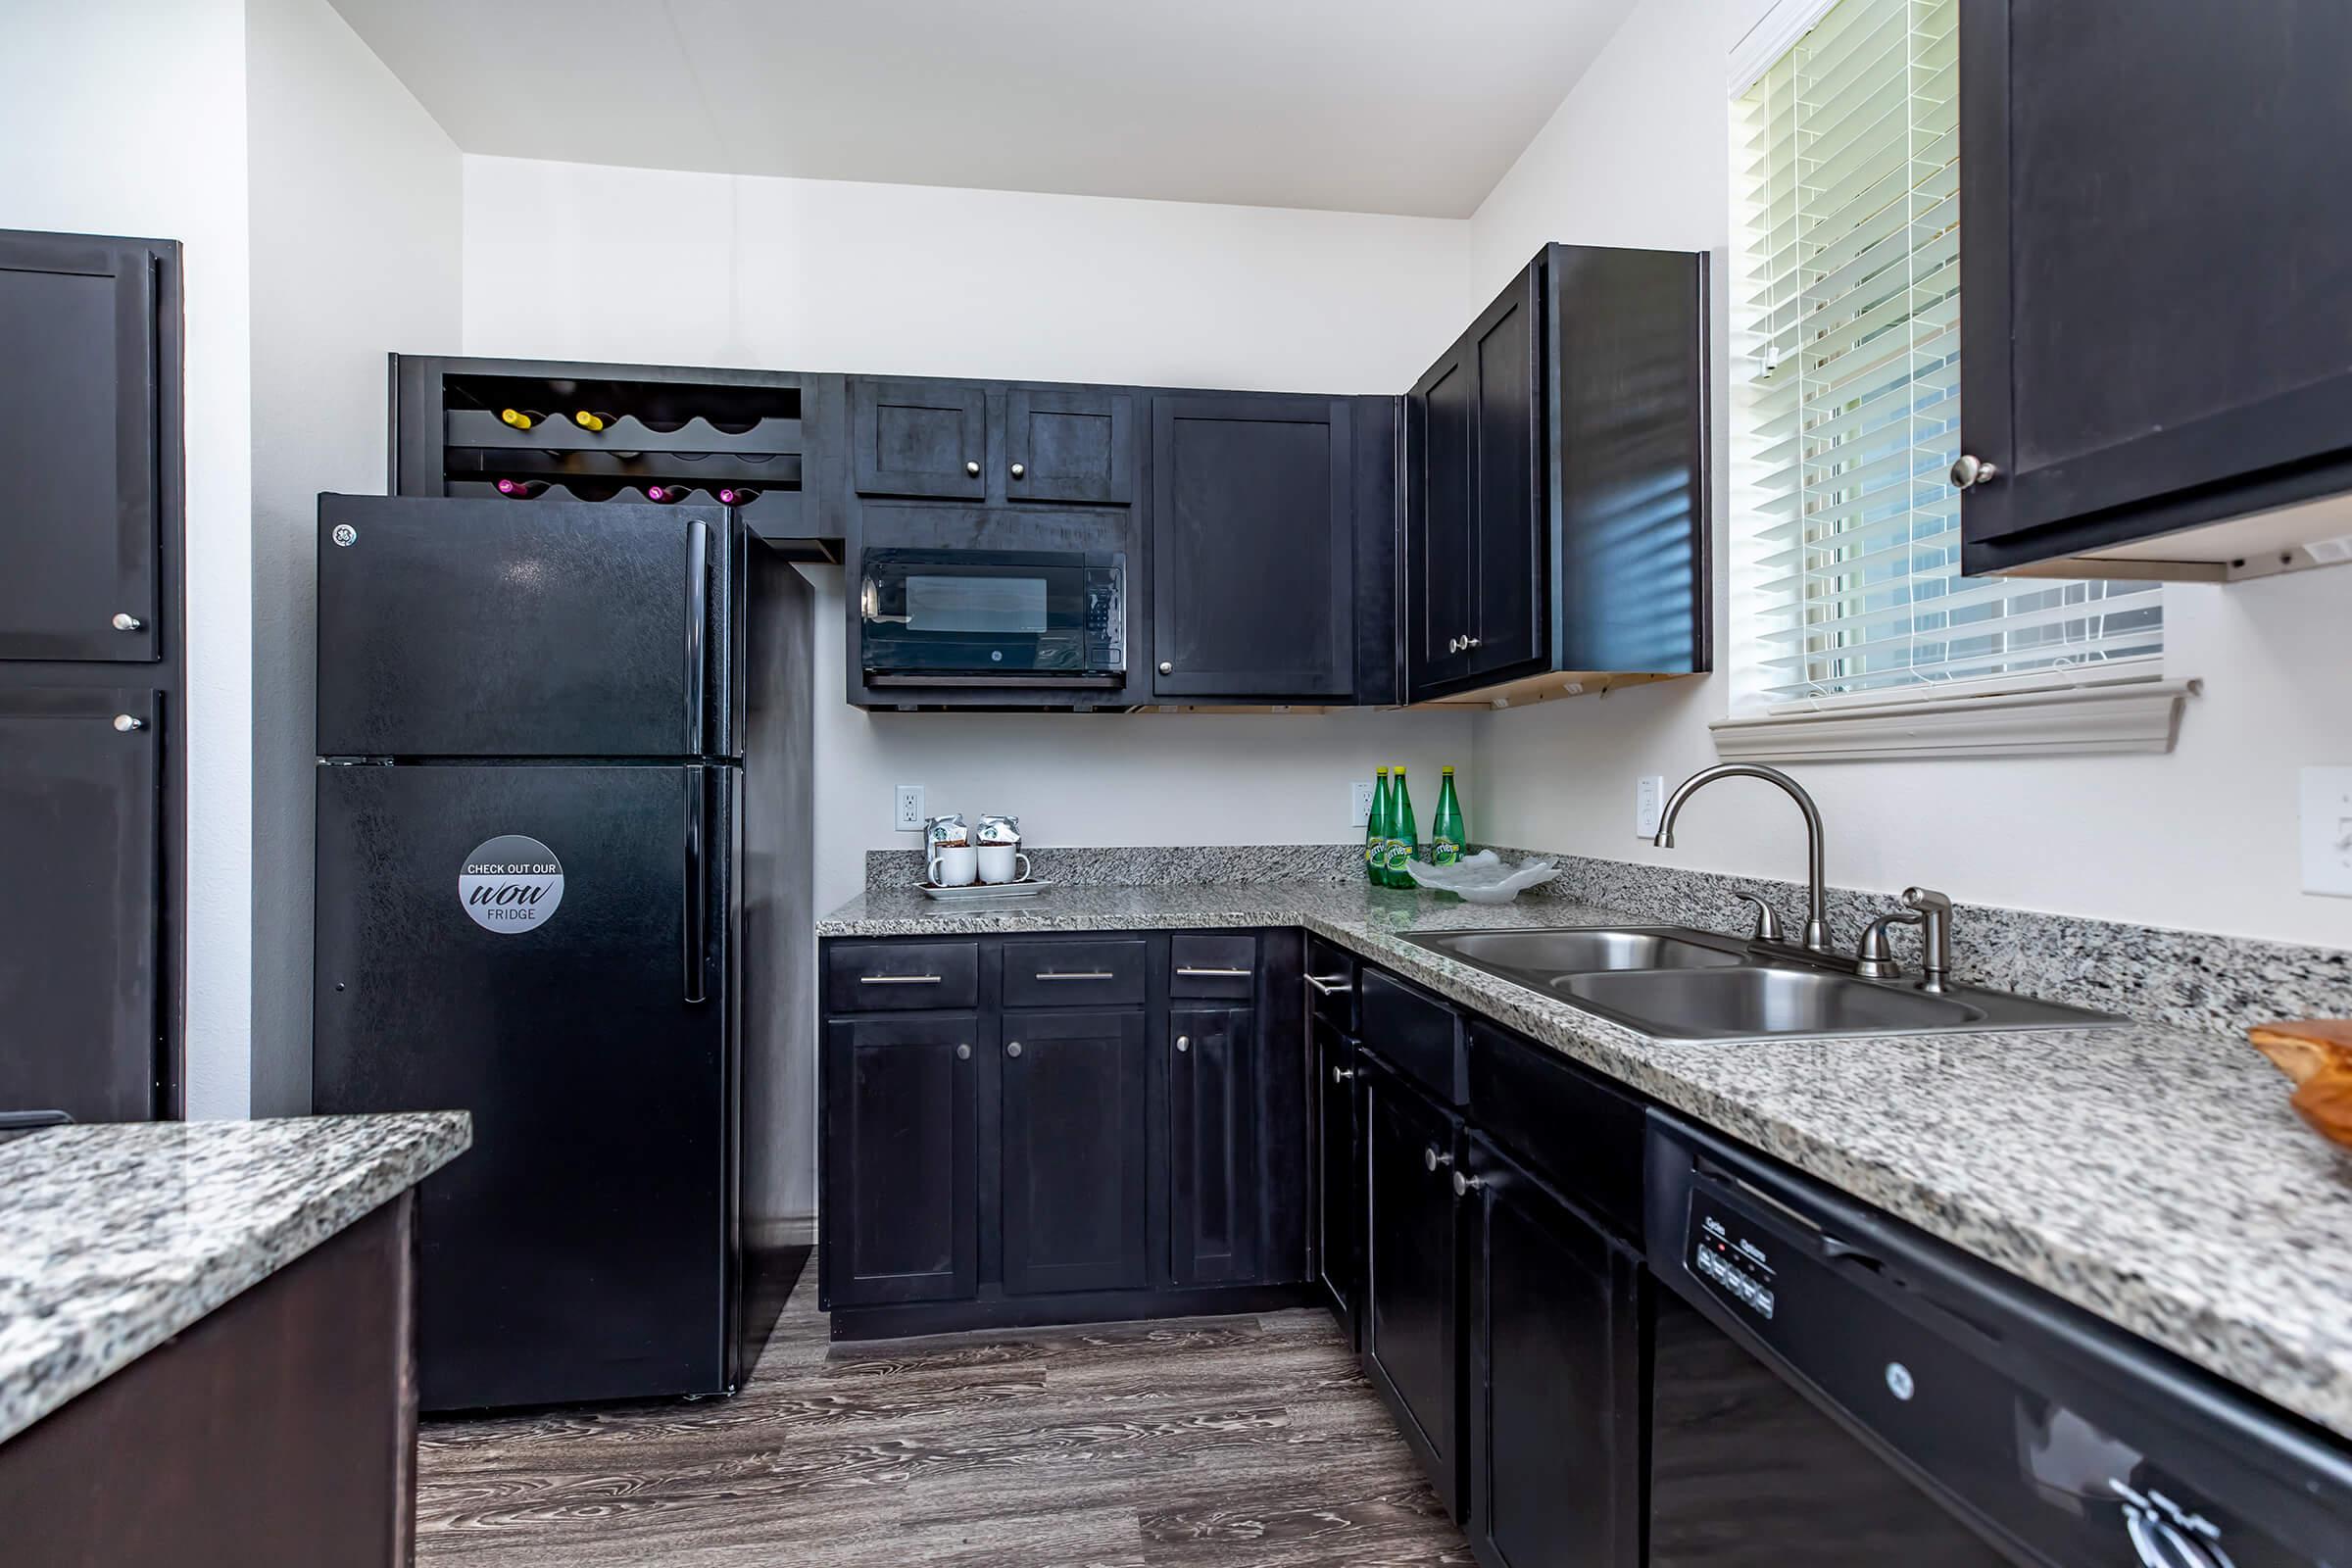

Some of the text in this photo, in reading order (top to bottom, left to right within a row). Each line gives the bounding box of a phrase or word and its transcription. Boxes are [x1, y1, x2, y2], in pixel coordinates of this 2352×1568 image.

[467, 863, 557, 874] CHECK OUT OUR
[487, 908, 536, 920] FRIDGE
